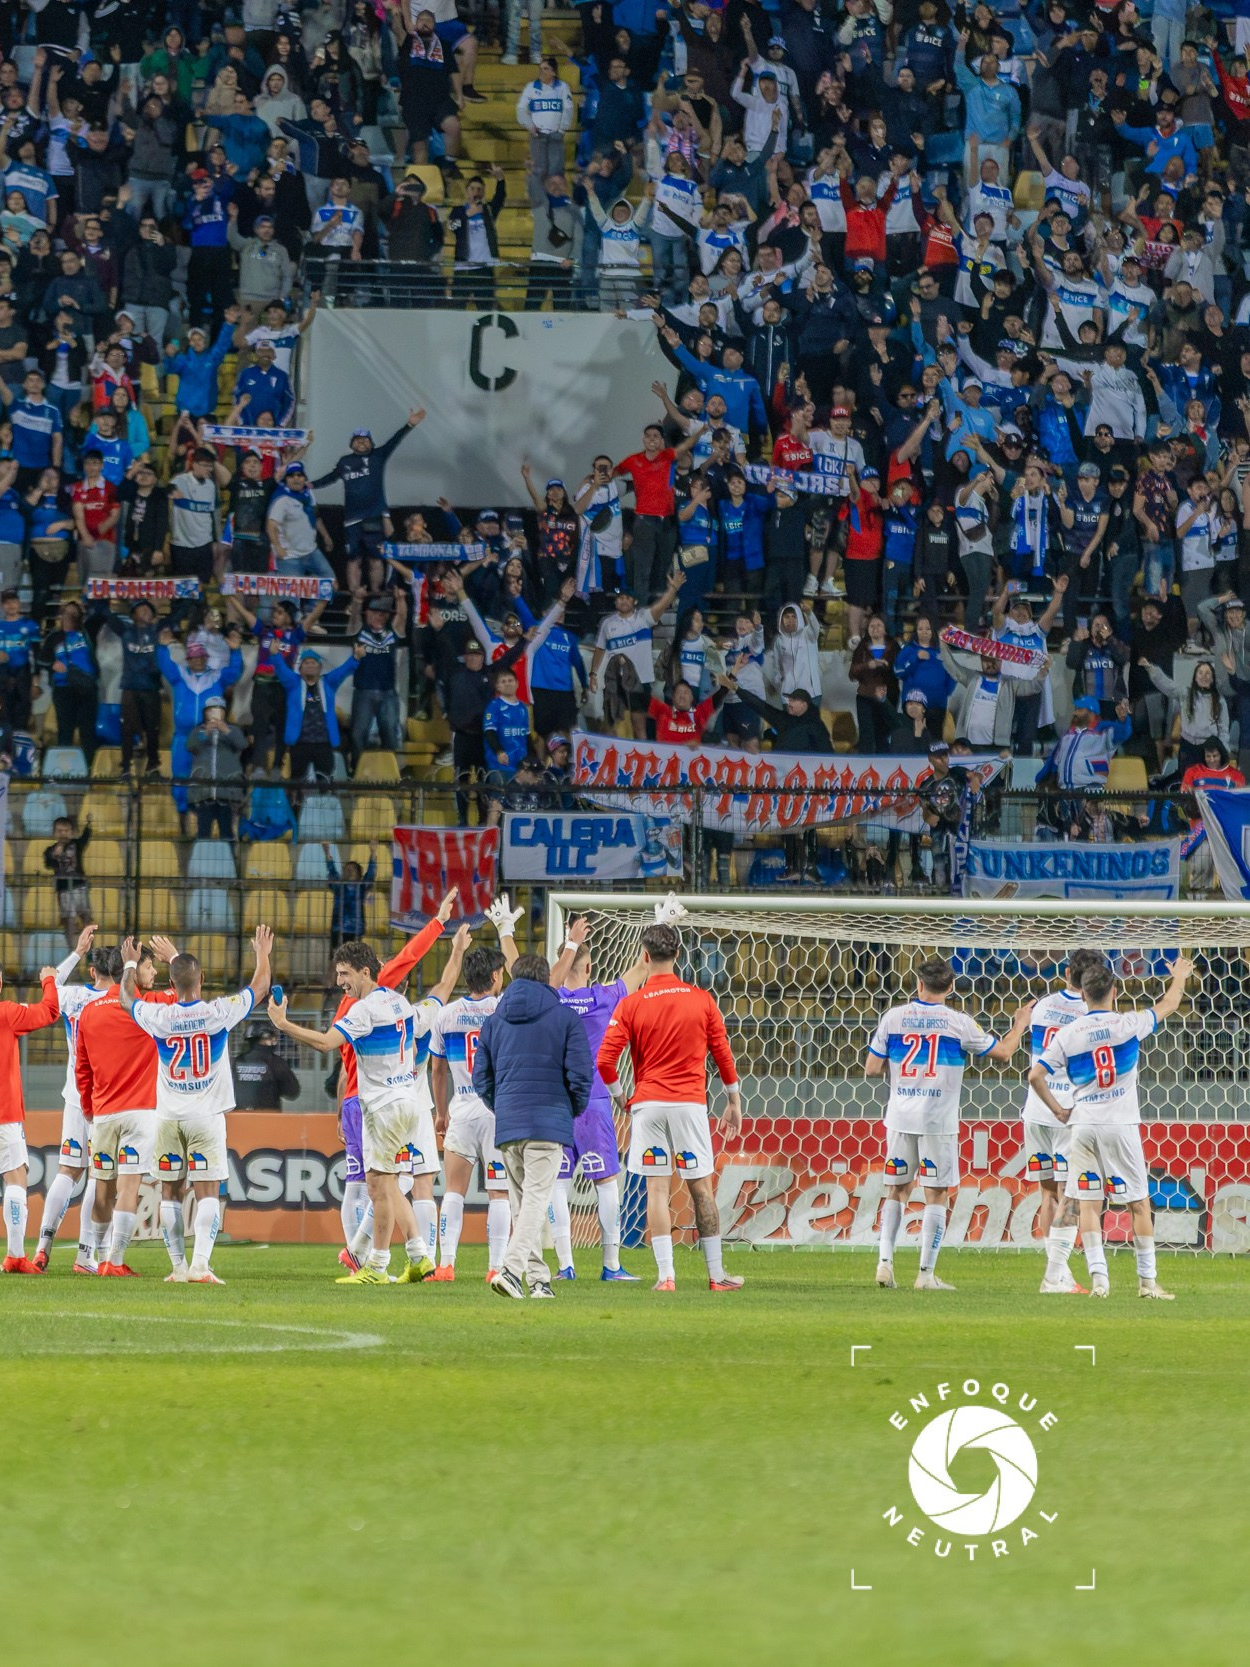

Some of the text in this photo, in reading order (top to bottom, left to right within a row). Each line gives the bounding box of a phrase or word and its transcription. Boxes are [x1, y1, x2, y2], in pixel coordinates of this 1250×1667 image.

[470, 314, 519, 391] C
[510, 817, 637, 847] CALERA
[559, 997, 594, 1005] APMOTOR
[643, 987, 692, 999] LEAPMOTOR
[166, 1033, 211, 1081] 20
[394, 1018, 407, 1065] 7
[901, 1032, 939, 1079] 21
[1092, 1044, 1117, 1089] 8
[897, 1086, 942, 1099] SAMSUNG
